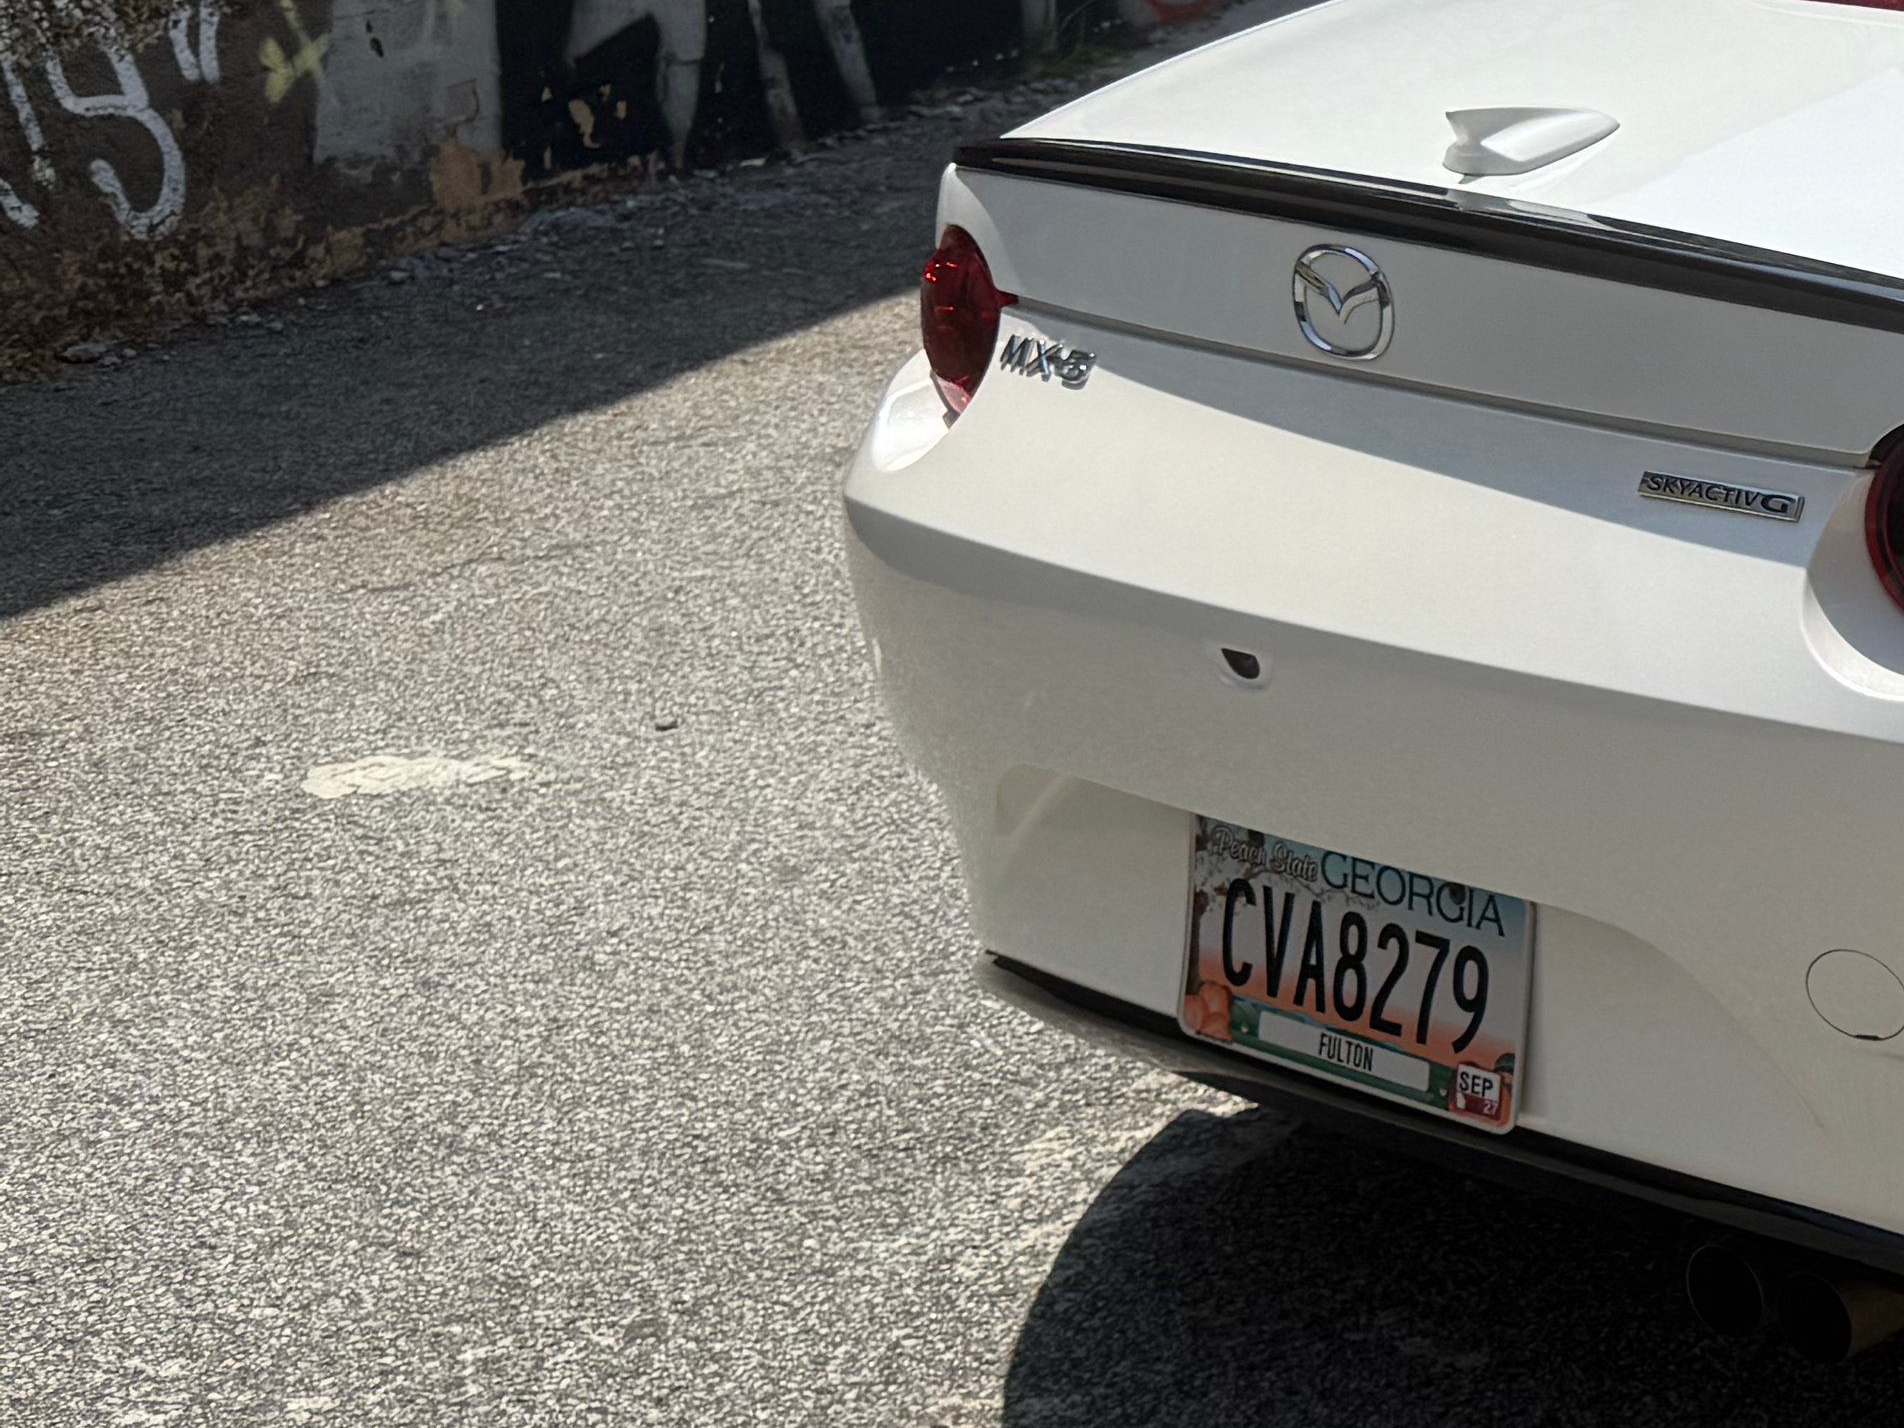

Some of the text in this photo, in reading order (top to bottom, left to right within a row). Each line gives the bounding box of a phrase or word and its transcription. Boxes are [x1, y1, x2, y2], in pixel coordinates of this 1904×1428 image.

[1320, 850, 1505, 937] GEORGIA
[1221, 877, 1489, 1055] CVA8279
[1318, 1032, 1374, 1072] FULTON
[1460, 1071, 1493, 1098] SEP
[1482, 1099, 1499, 1115] 27
